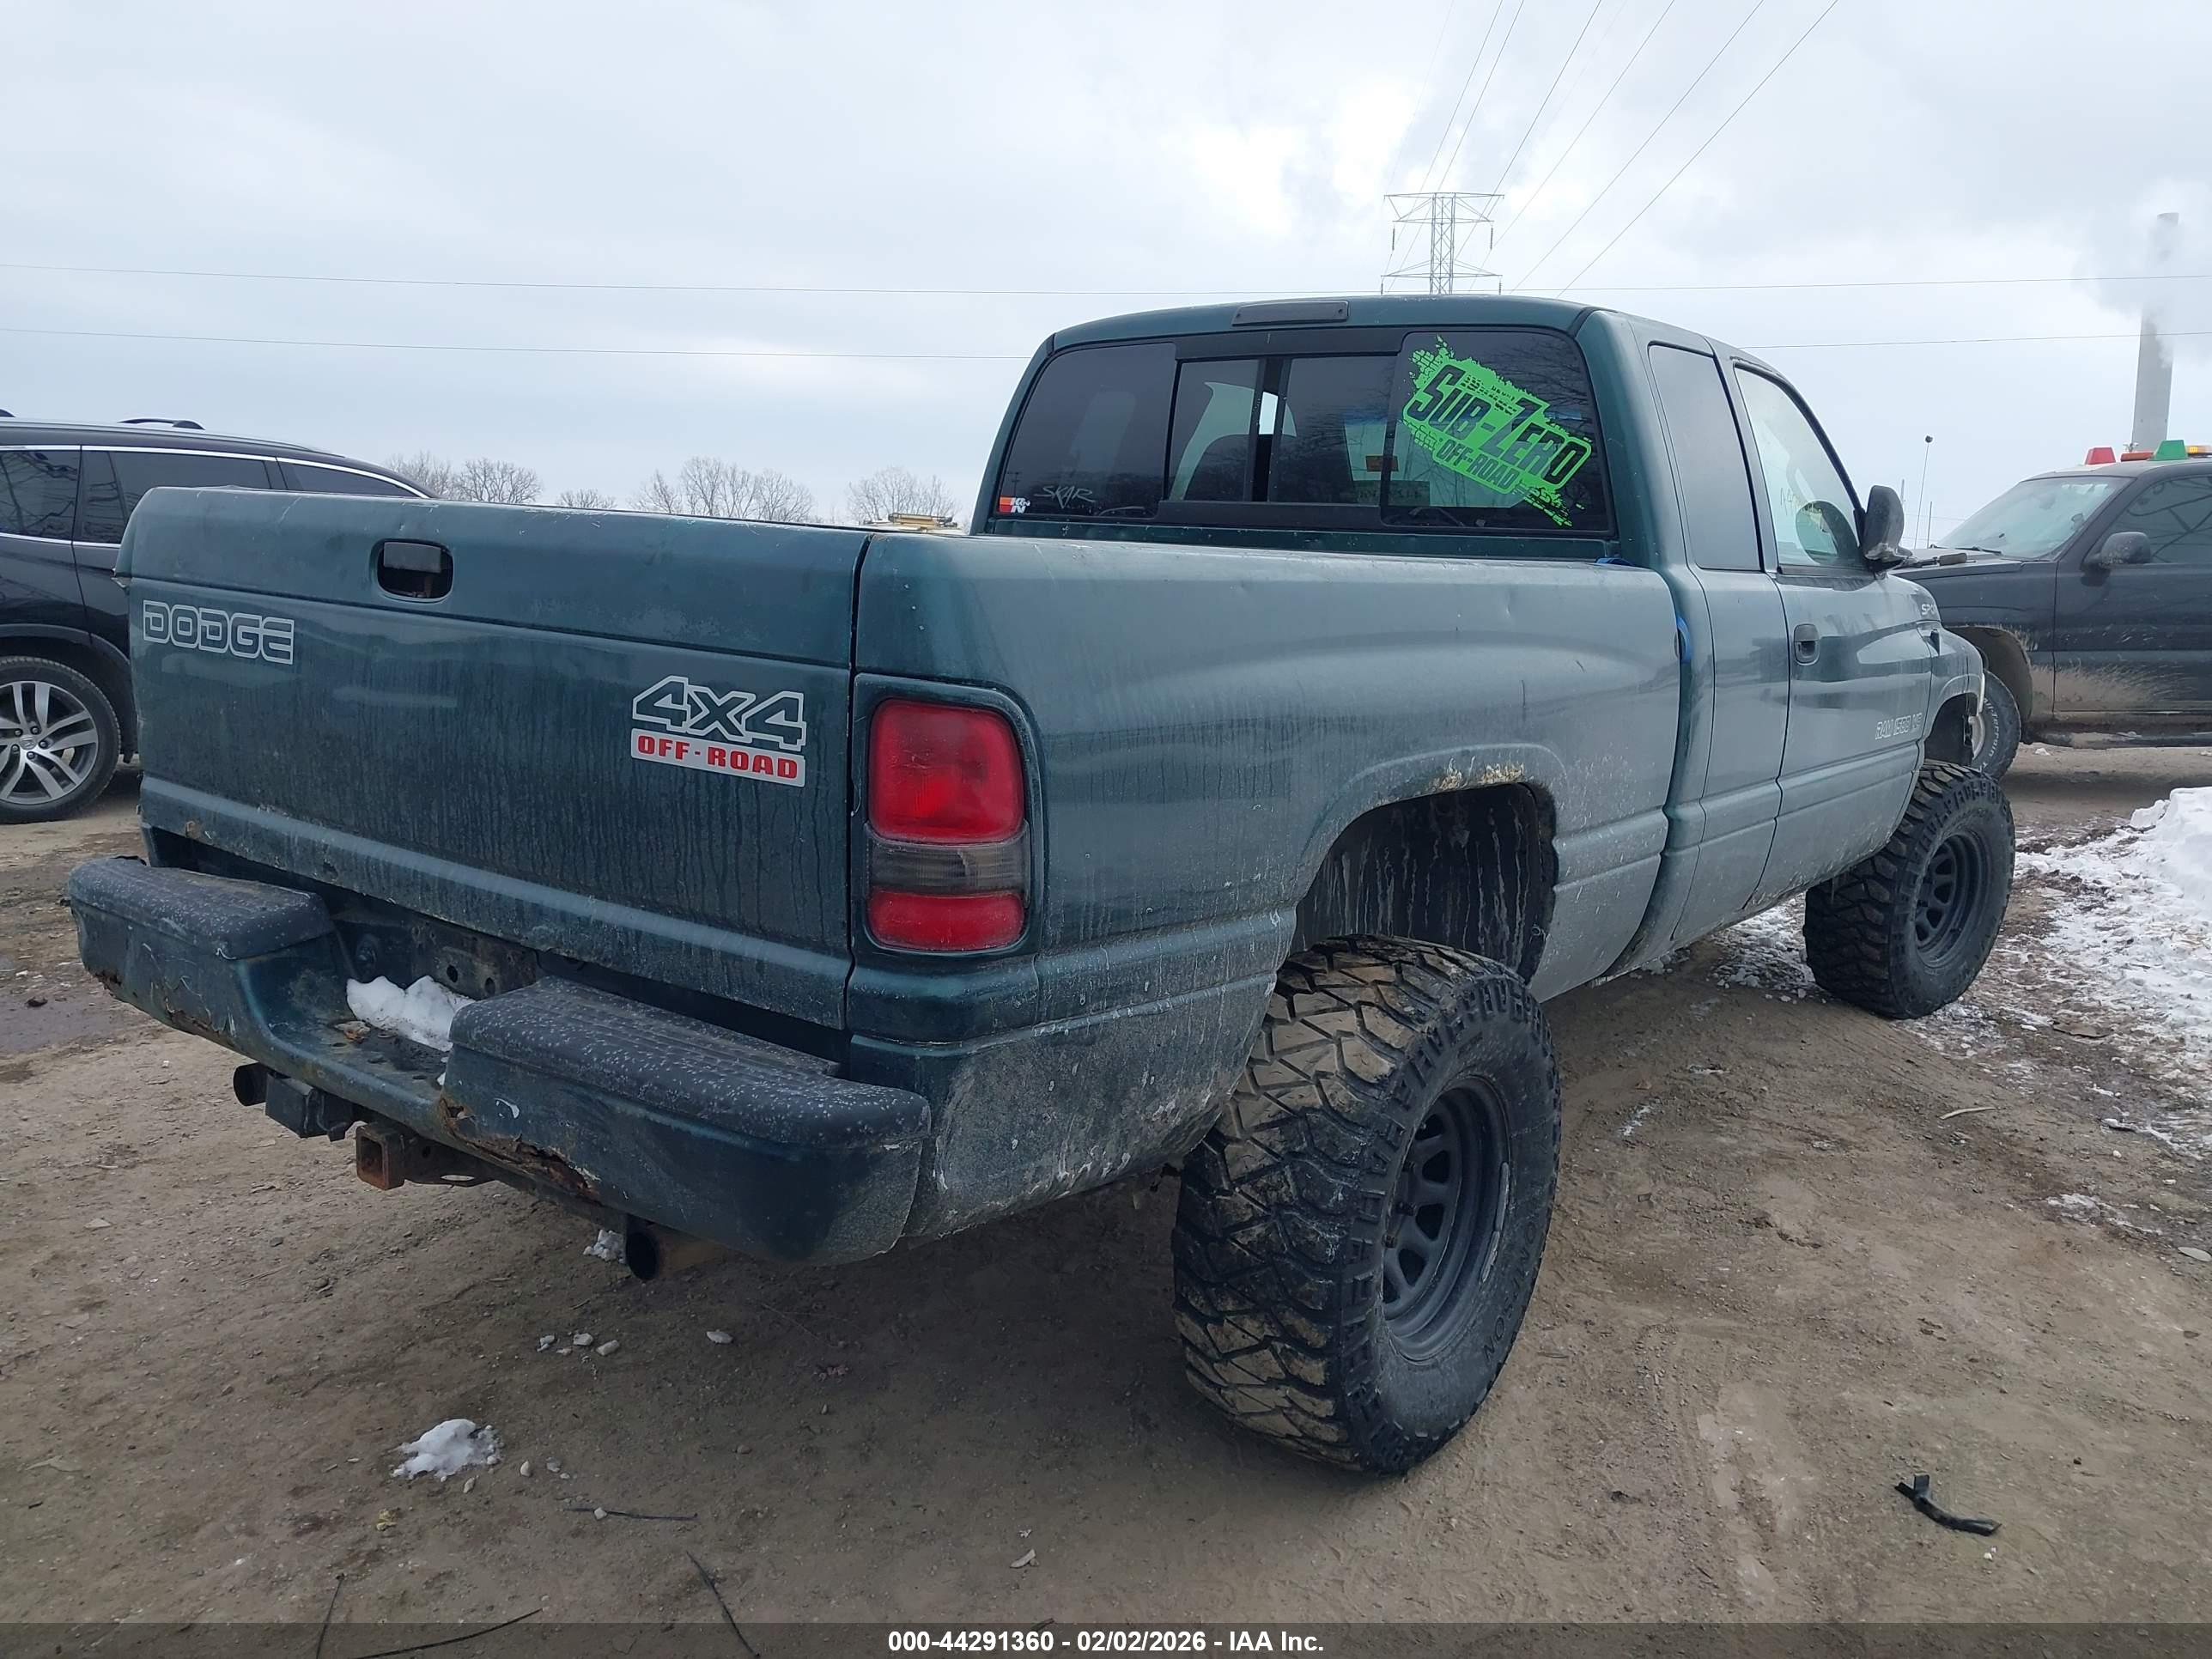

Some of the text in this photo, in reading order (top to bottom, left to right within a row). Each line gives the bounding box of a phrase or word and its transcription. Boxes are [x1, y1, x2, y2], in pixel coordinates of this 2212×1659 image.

[1407, 364, 1588, 485] SUB-ZERO
[1437, 439, 1521, 490] OFF-ROAD
[1033, 486, 1096, 508] SKAR
[143, 599, 295, 665] DODGE
[1921, 603, 1938, 616] SPO
[638, 735, 798, 779] OFF-ROAD
